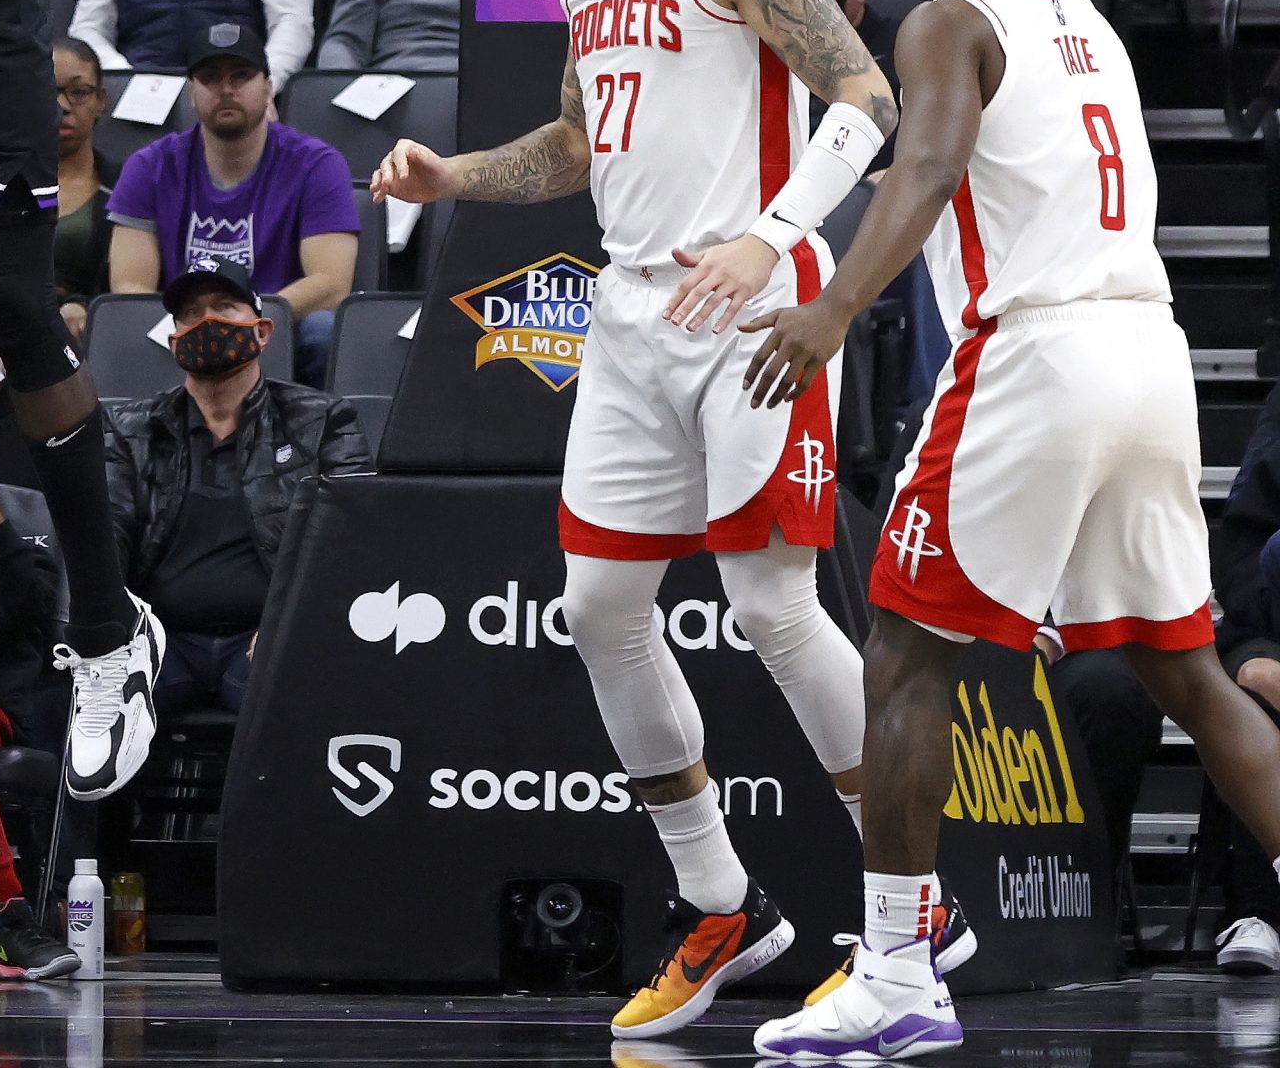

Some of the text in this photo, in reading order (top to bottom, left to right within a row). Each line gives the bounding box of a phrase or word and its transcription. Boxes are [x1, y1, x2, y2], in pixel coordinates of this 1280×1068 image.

[1053, 34, 1100, 76] TATE
[594, 72, 642, 153] 27
[1081, 103, 1126, 231] 8
[483, 296, 592, 328] DIAMO
[998, 854, 1093, 919] Credit Union
